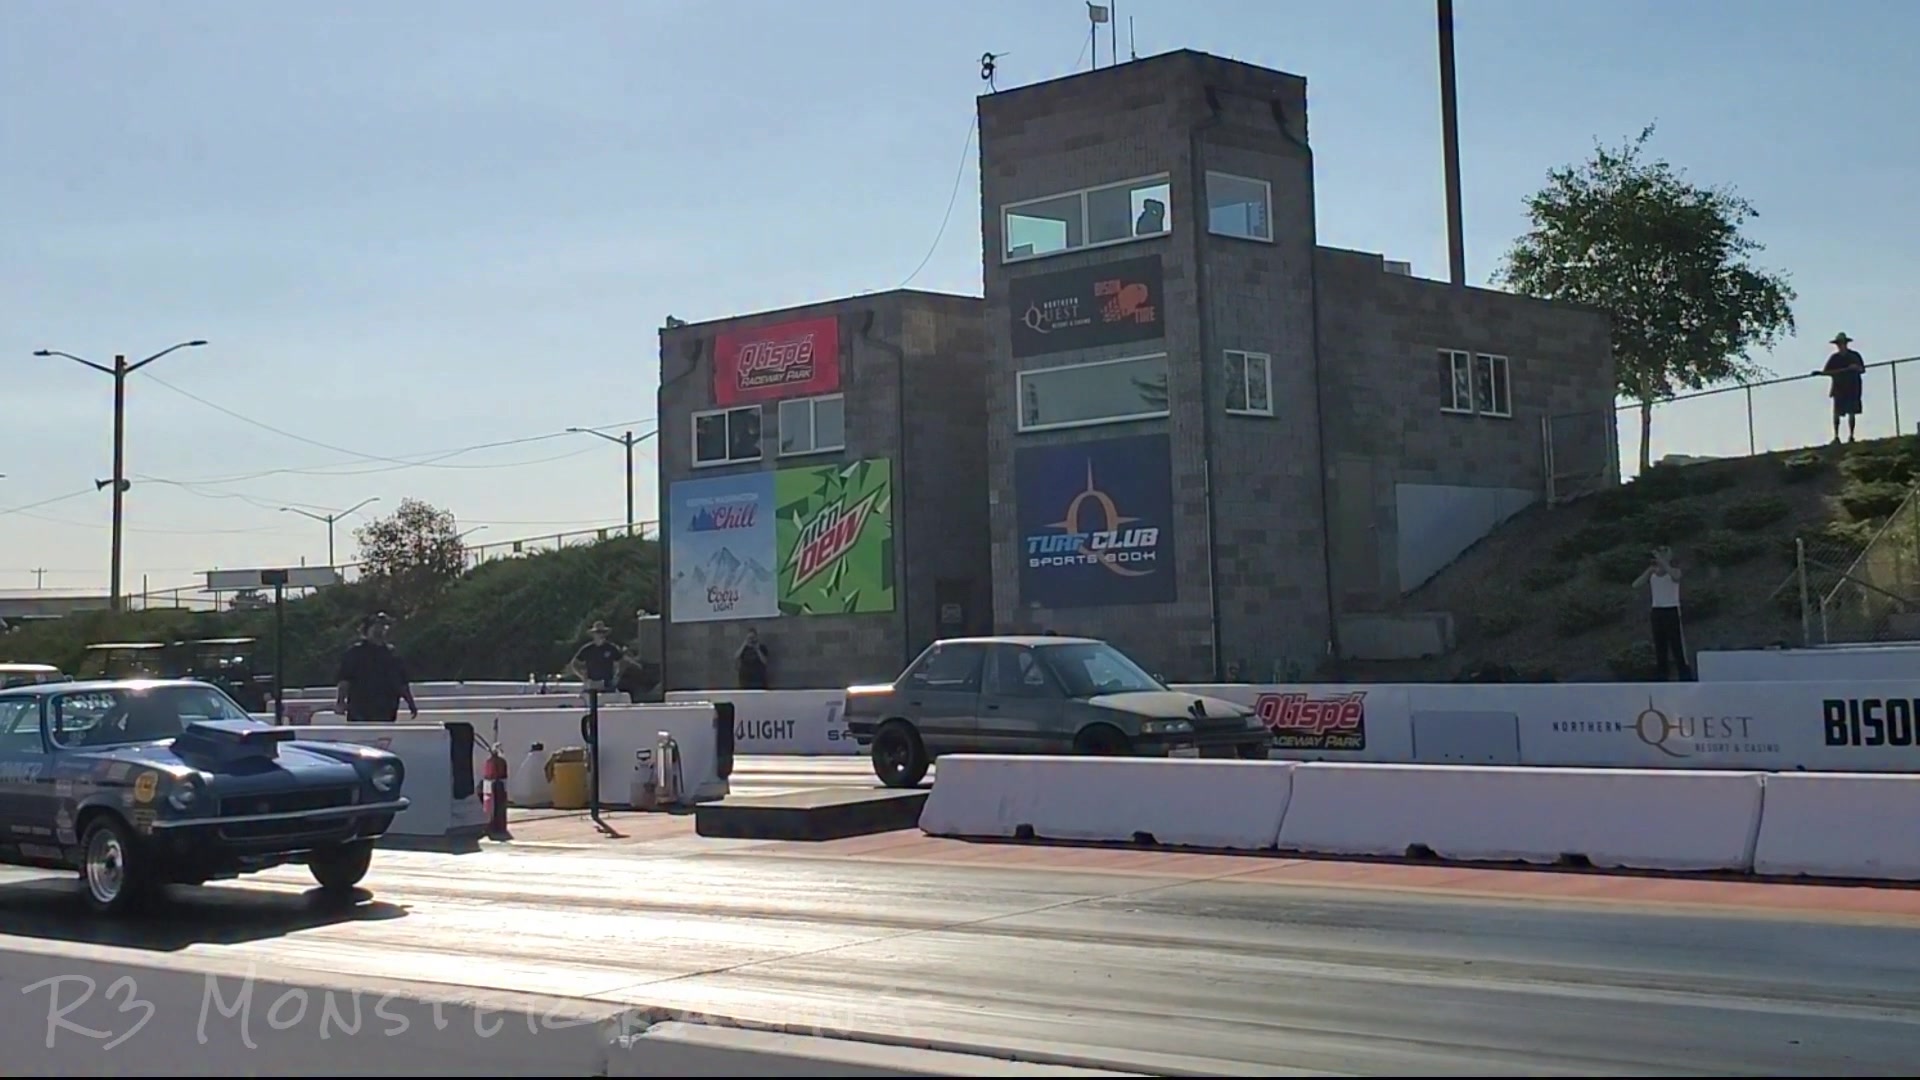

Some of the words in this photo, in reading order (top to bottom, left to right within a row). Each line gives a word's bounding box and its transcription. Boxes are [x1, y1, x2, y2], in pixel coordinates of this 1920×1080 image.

[1024, 303, 1079, 333] QUEST
[741, 373, 785, 387] RACEWAY
[786, 369, 812, 382] PARK
[712, 503, 758, 529] Chill
[1027, 533, 1089, 554] TURF
[1091, 528, 1159, 550] CLUB
[1029, 554, 1098, 567] SPORTS
[1104, 551, 1156, 563] BOOK
[706, 586, 739, 603] Coors
[713, 603, 734, 612] LIGHT
[747, 720, 795, 739] LIGHT
[1553, 721, 1622, 732] NORTHERN
[1634, 702, 1753, 757] QUEST
[1823, 699, 1920, 746] BISO
[1266, 734, 1322, 747] ACEWAY
[1325, 734, 1362, 748] PARK
[1695, 743, 1730, 752] RESORT
[1744, 743, 1780, 752] CASINO
